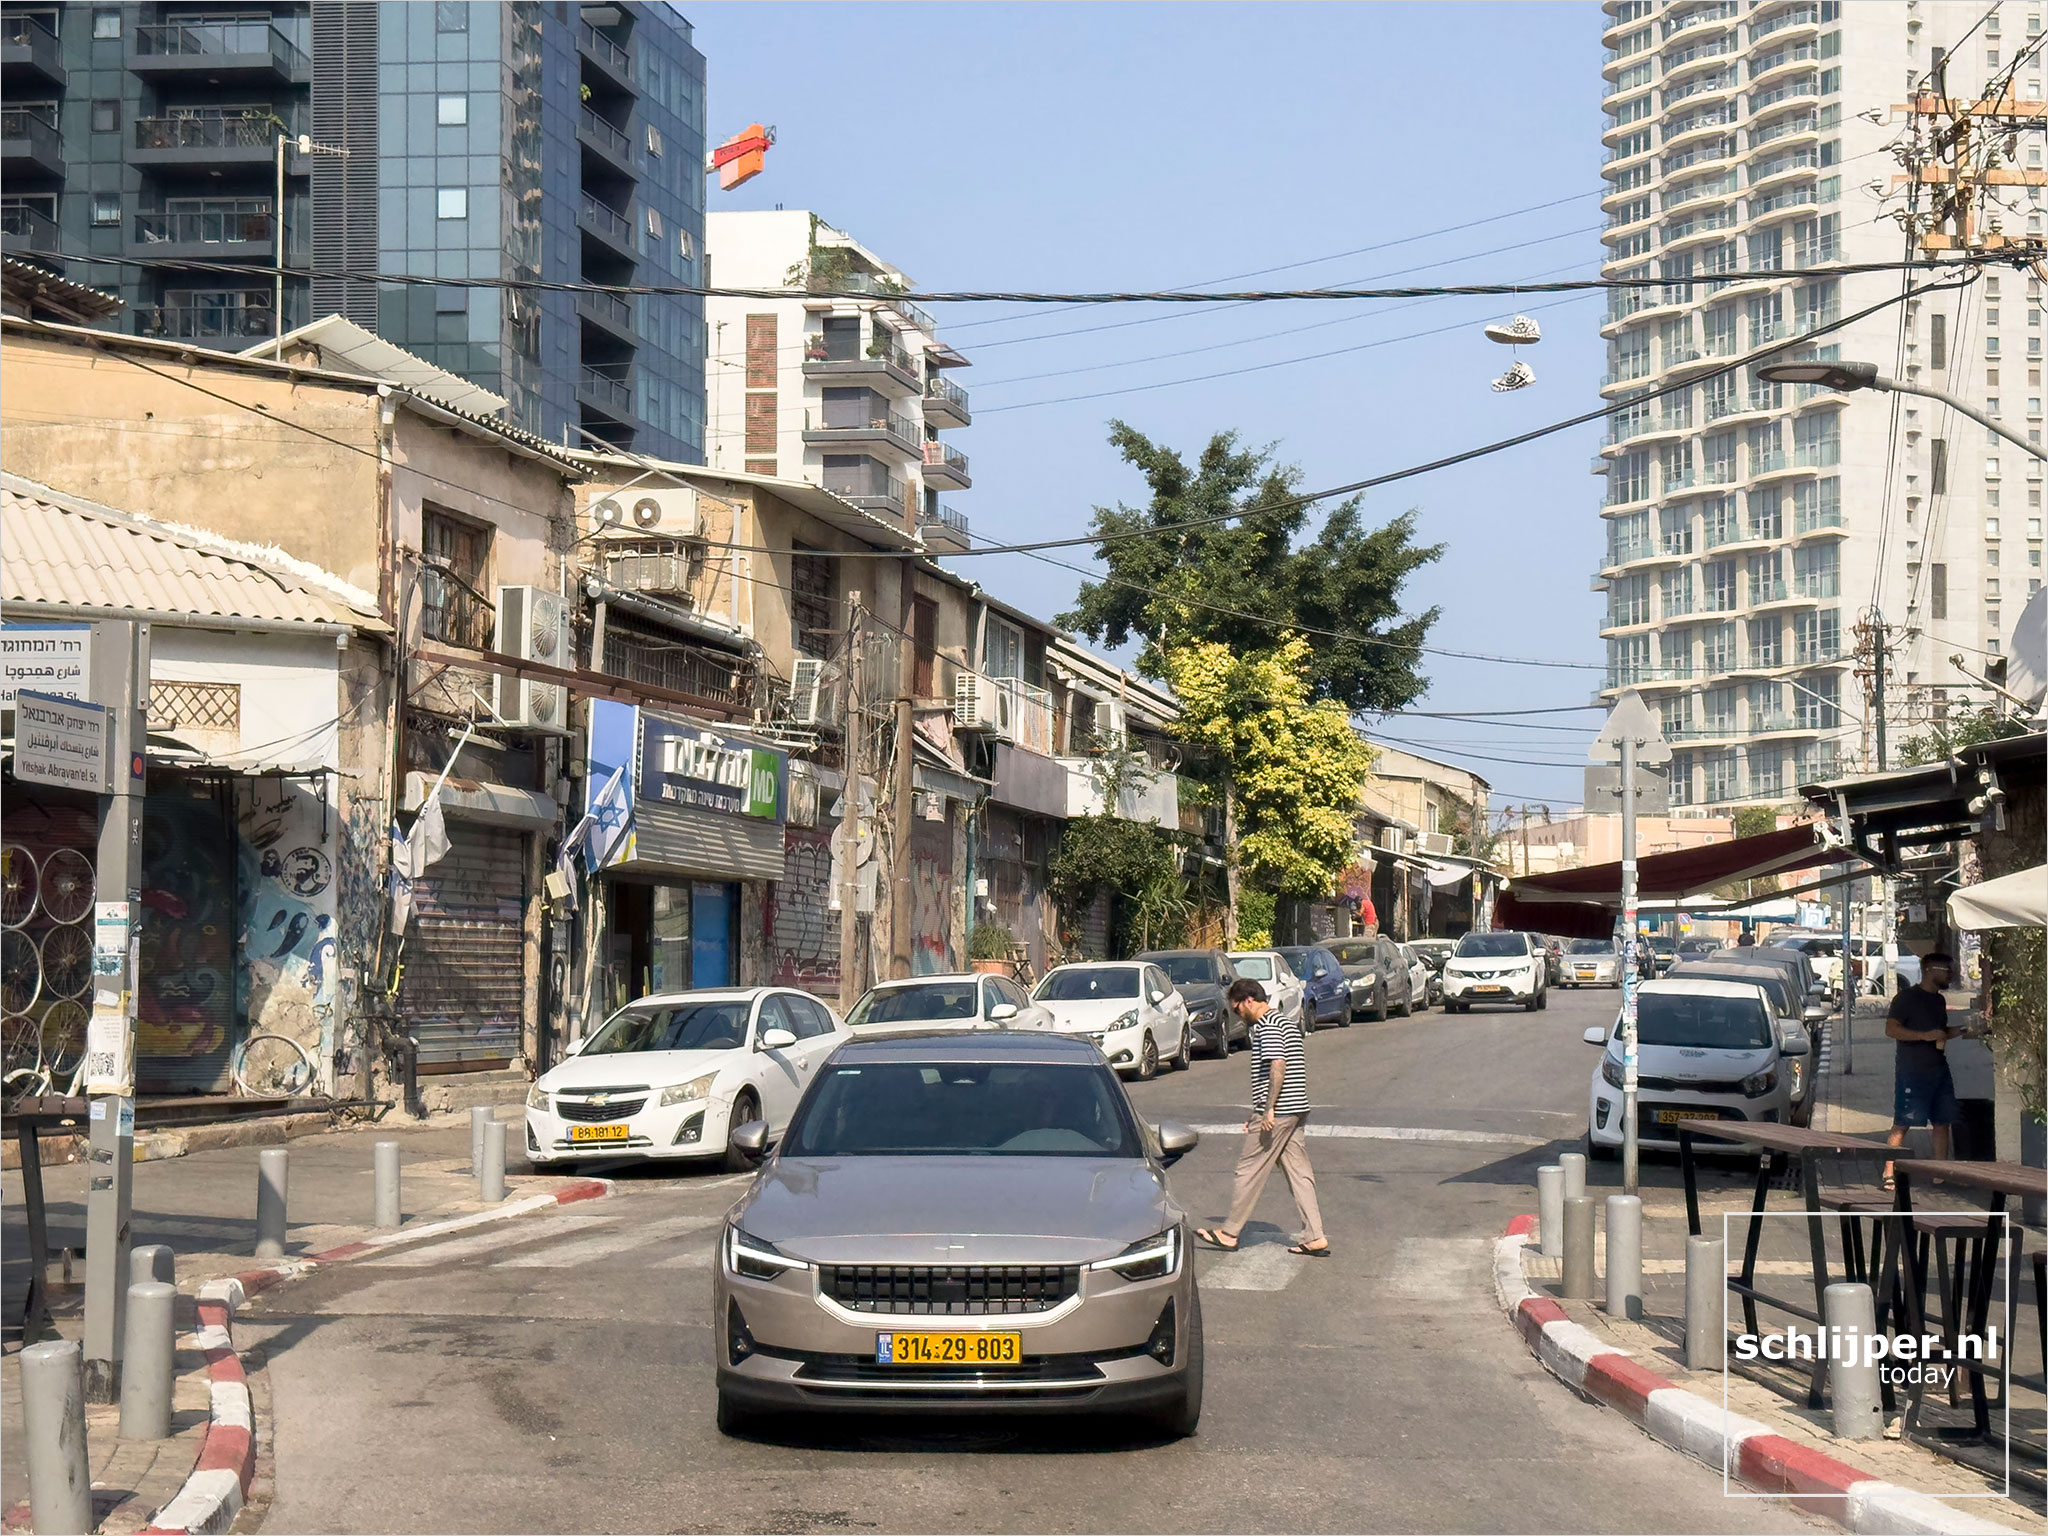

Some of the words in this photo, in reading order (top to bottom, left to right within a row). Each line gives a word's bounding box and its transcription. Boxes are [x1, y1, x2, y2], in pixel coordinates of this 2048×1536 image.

[57, 664, 81, 680] شارع
[21, 703, 65, 726] אברבנאל
[66, 716, 87, 731] יצחק
[84, 745, 99, 760] شارع
[753, 768, 775, 804] MD
